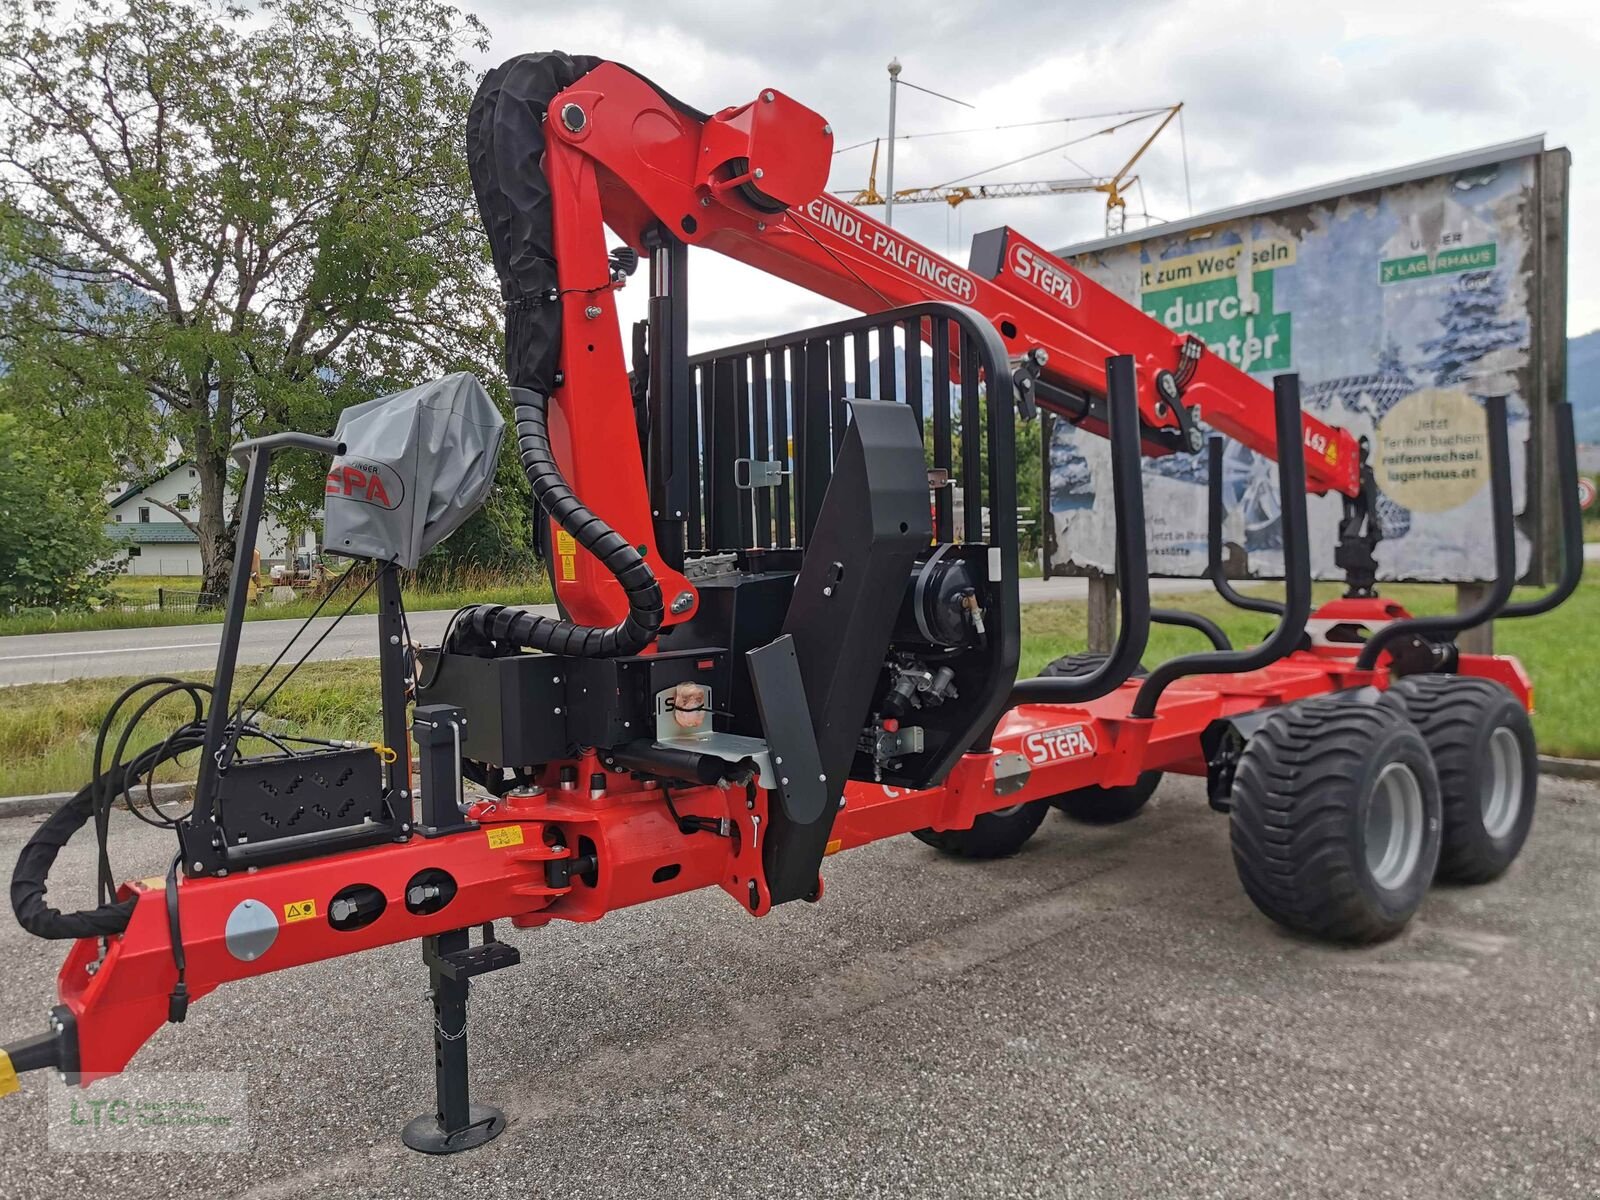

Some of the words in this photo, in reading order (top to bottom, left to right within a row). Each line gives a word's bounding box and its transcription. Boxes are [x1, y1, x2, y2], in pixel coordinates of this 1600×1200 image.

[798, 199, 973, 301] EINDL-PALFINGER
[1157, 266, 1192, 284] zum
[1197, 243, 1289, 276] Wecseln
[1397, 250, 1493, 275] LAGRHAUS
[1014, 247, 1073, 306] STEPA
[1163, 292, 1261, 329] durch
[1304, 426, 1327, 455] L62
[1414, 418, 1448, 431] Jetzt
[1026, 731, 1094, 764] STEPA
